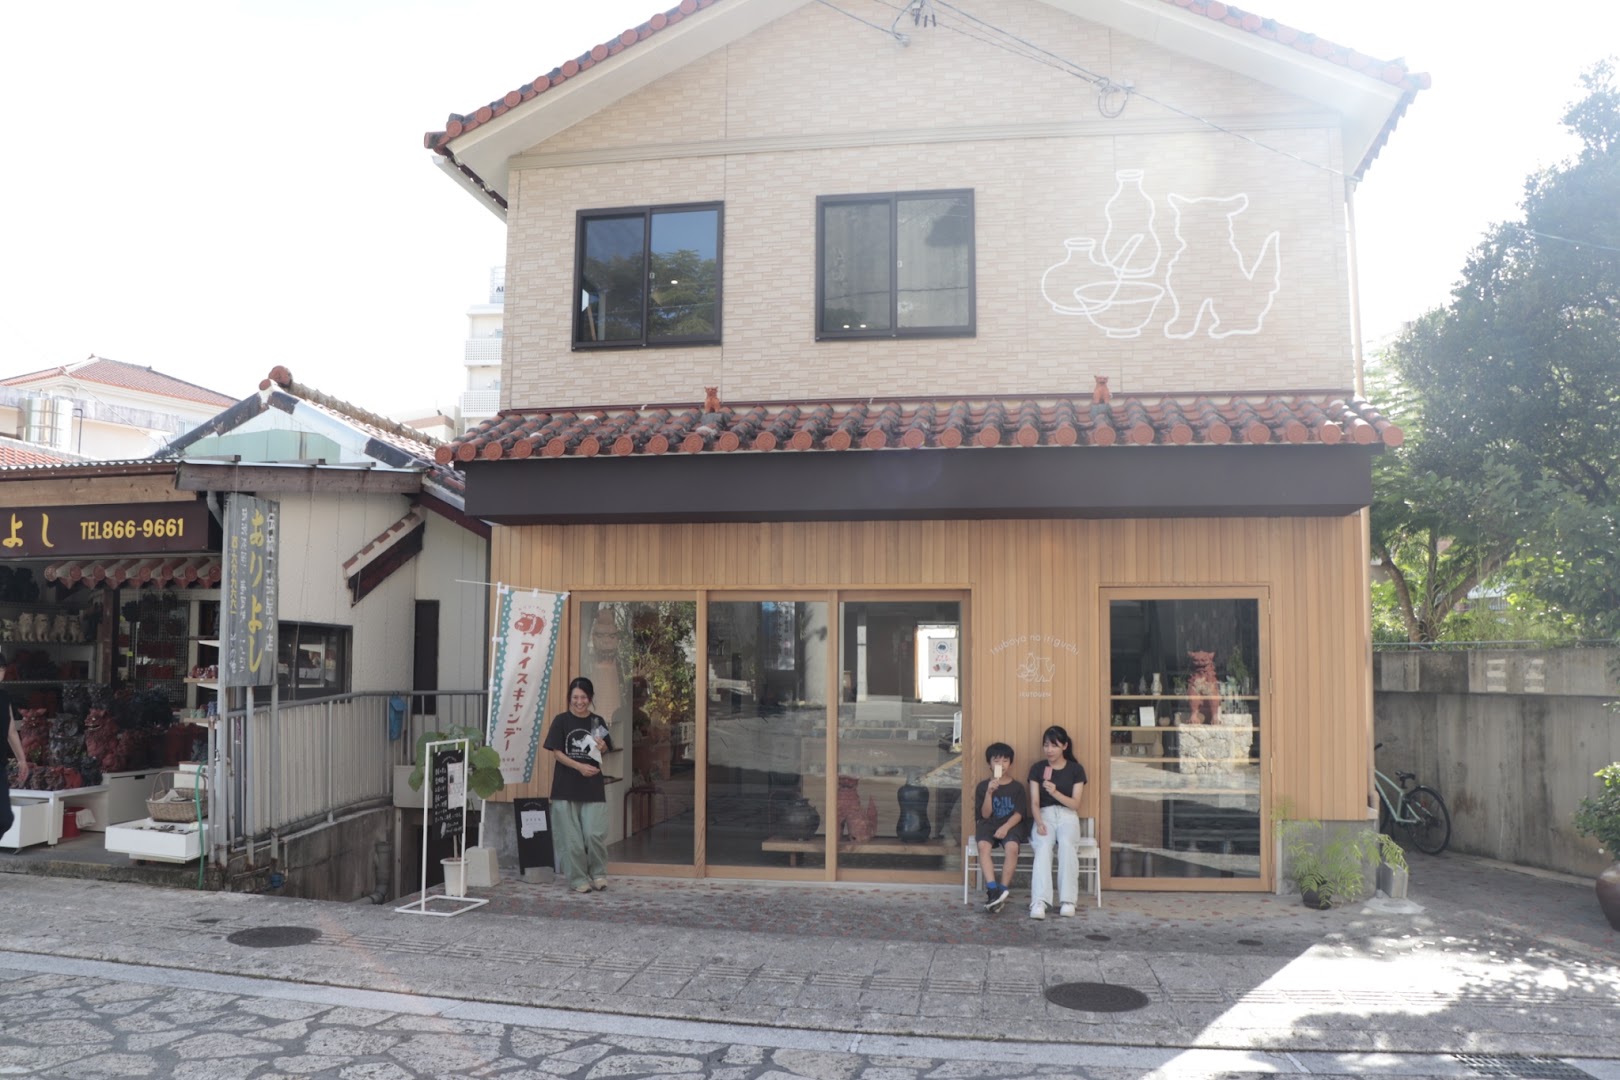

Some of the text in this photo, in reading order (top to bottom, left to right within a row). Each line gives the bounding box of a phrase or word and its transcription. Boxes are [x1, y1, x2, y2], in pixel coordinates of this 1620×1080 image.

[248, 508, 265, 673] ありよし
[503, 641, 535, 751] アイスキャンデー
